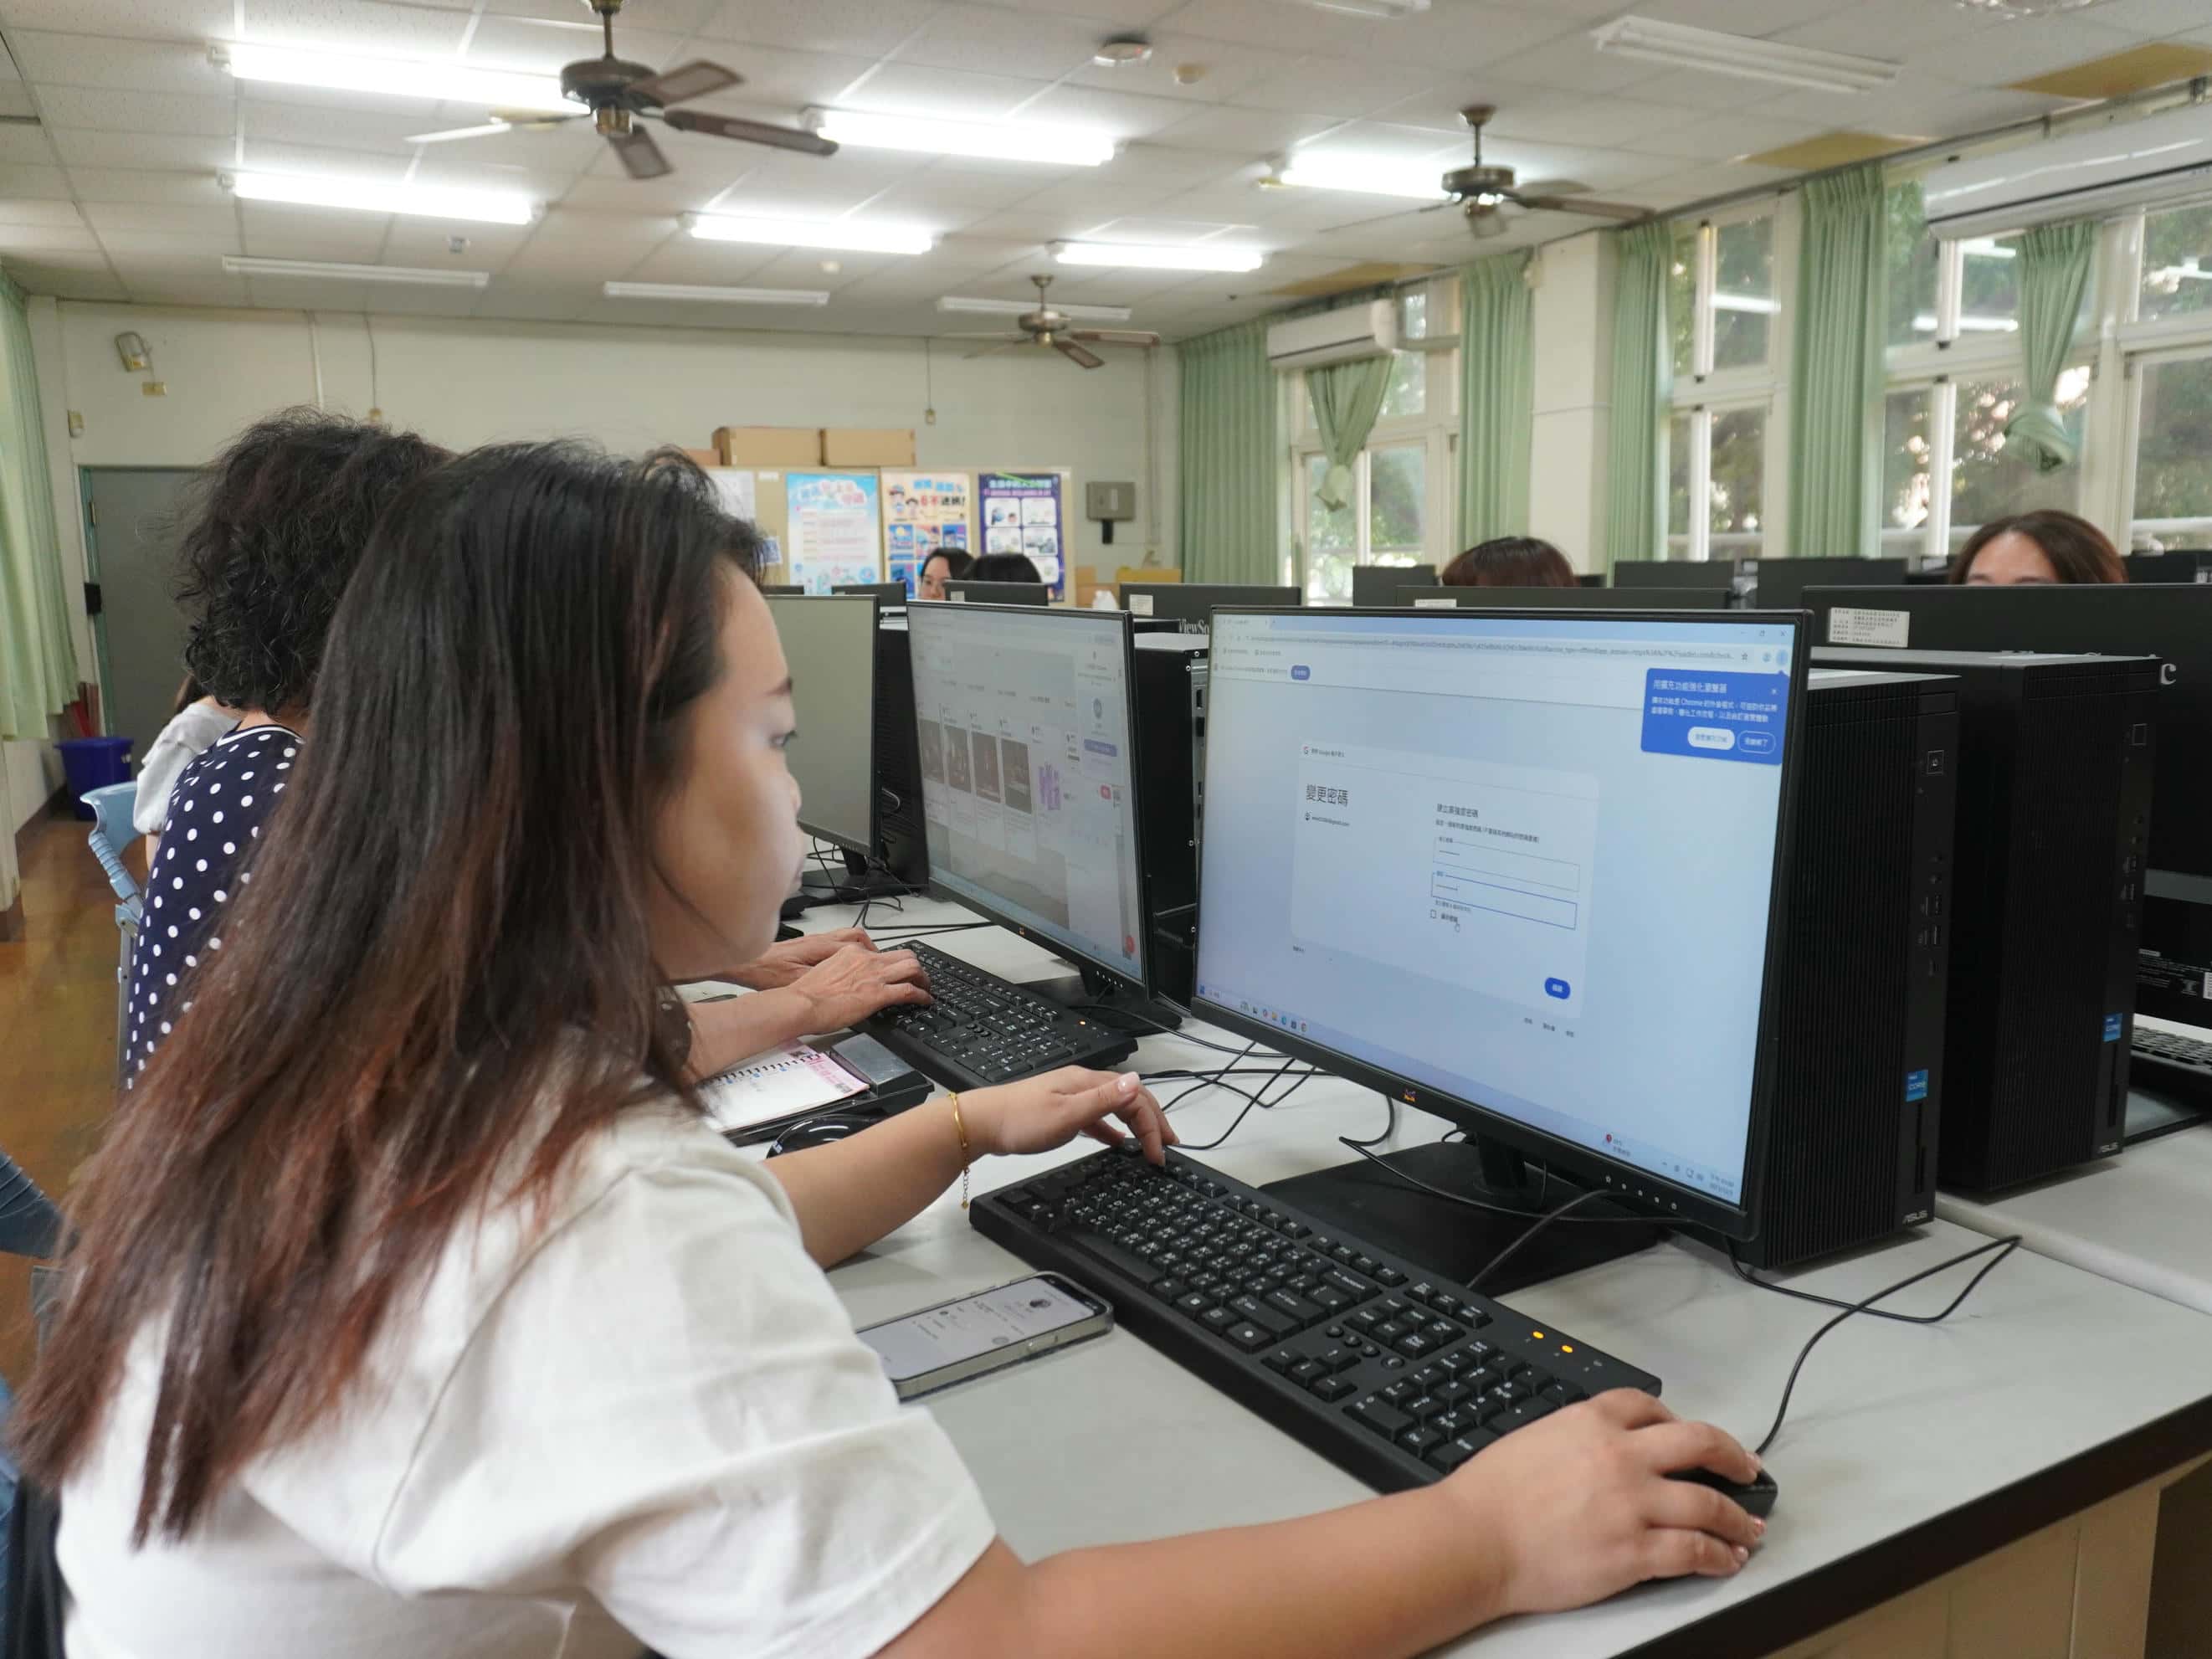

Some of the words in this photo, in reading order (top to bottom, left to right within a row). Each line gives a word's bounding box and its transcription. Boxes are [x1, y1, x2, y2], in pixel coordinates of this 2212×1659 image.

[1179, 619, 1209, 634] ViewSo
[1306, 783, 1349, 808] 變更密碼
